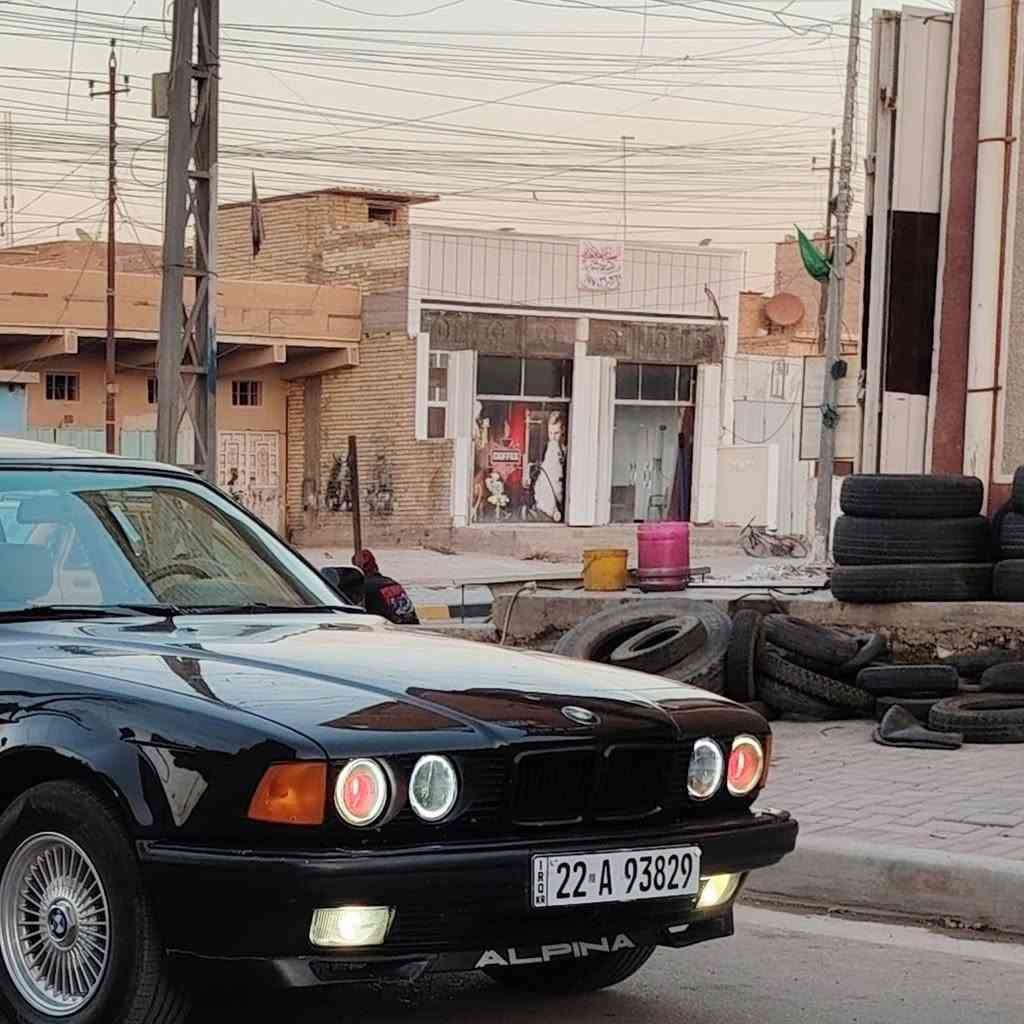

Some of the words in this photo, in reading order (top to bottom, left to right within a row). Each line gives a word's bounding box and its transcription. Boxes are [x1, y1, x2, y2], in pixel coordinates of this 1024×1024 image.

[556, 861, 587, 899] 22
[598, 859, 613, 896] A
[624, 853, 693, 894] 93829
[475, 933, 635, 969] ALPINA
